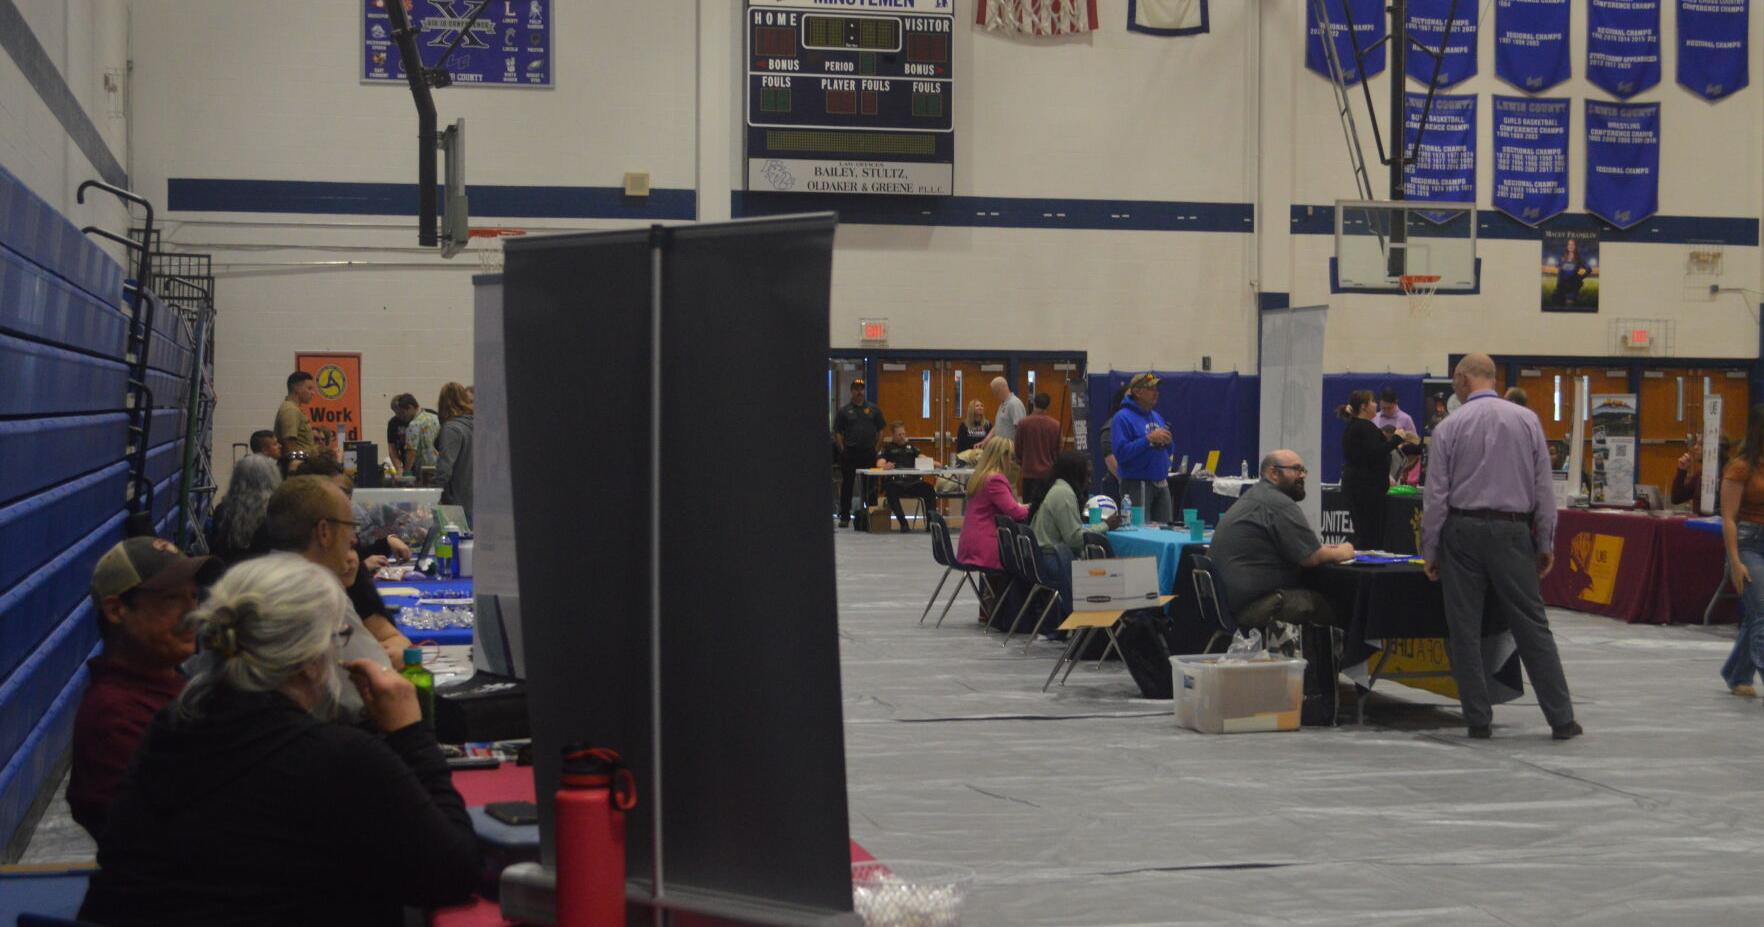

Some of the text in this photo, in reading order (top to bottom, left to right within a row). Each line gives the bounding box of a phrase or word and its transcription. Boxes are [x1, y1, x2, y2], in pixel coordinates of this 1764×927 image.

[754, 12, 797, 26] HOME
[905, 19, 949, 32] VISITOR
[768, 59, 800, 71] BONUS
[825, 61, 854, 72] PERIOD
[904, 64, 935, 75] BONUS
[457, 73, 484, 81] COUNTY
[762, 77, 791, 87] FOULS
[821, 79, 890, 91] PLAYER FOULS
[912, 82, 941, 93] FOULS
[1406, 121, 1445, 130] CONFRENCE
[814, 167, 908, 179] BAILEY, STULTZ,
[807, 181, 858, 191] OLDAKER
[861, 182, 868, 191] &
[871, 182, 914, 193] GREENE
[309, 408, 352, 422] Work
